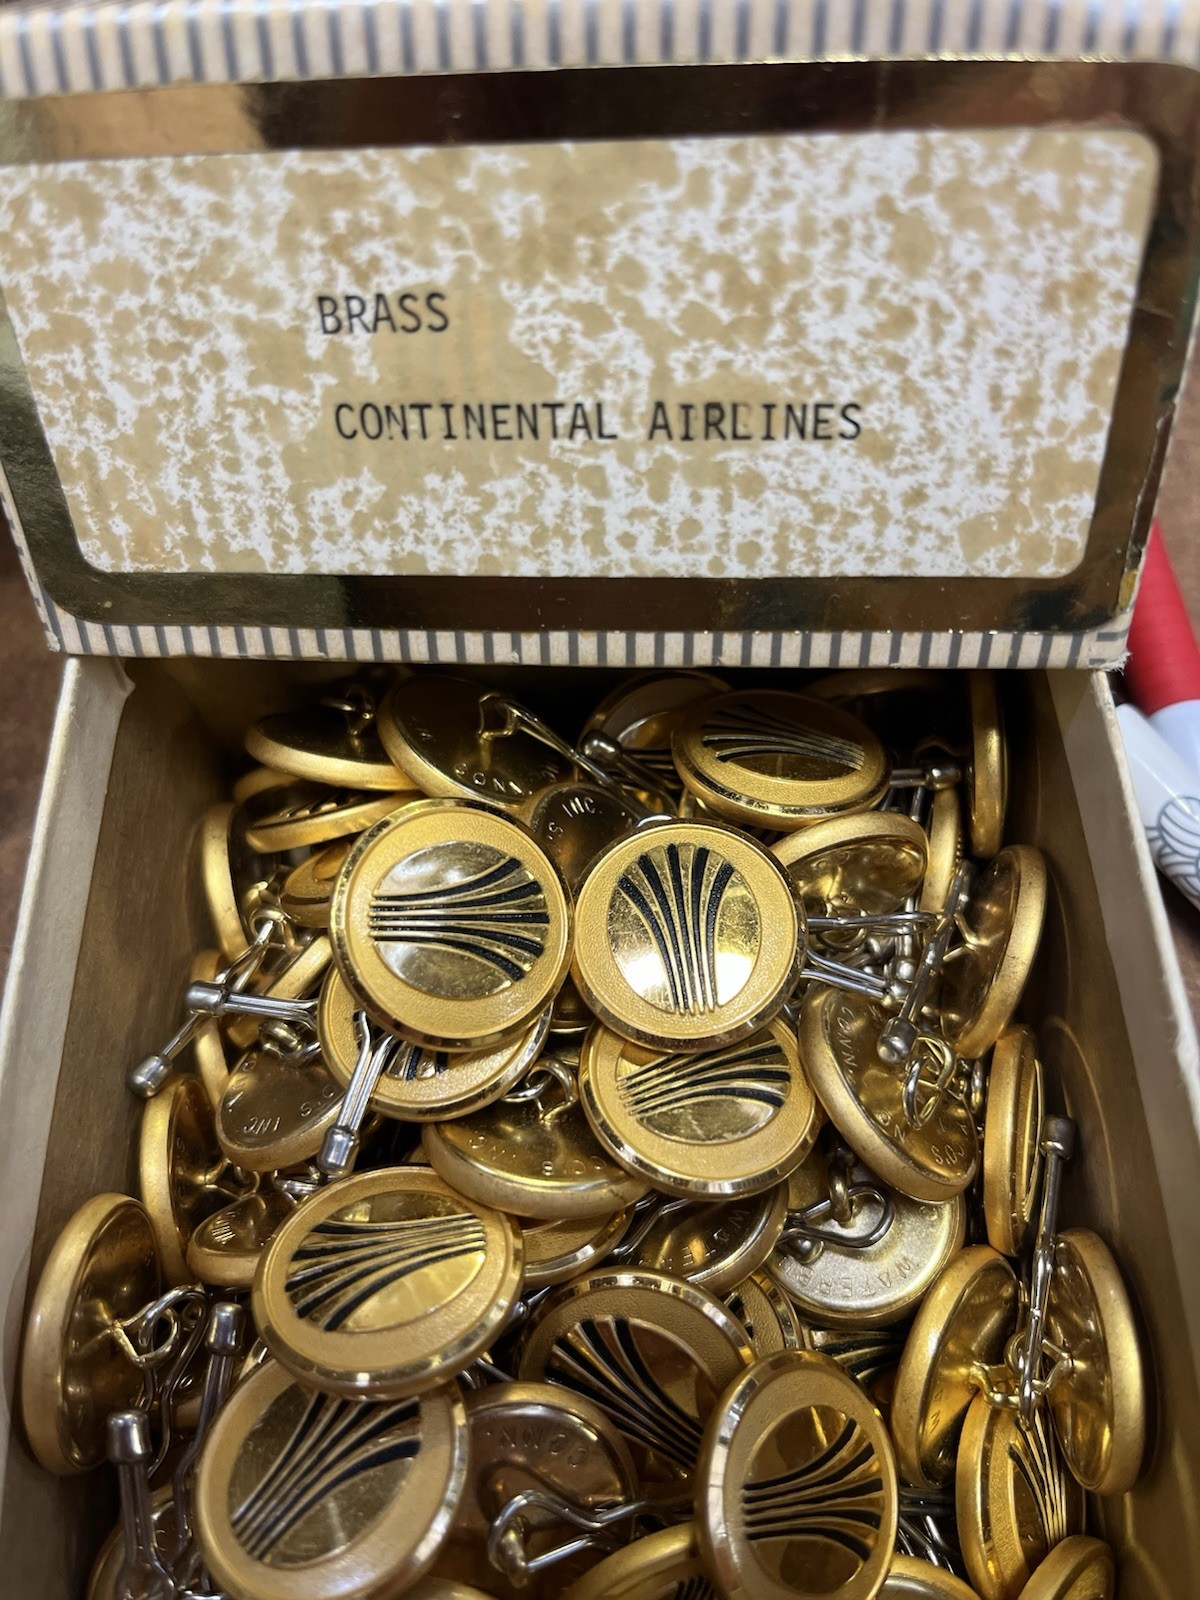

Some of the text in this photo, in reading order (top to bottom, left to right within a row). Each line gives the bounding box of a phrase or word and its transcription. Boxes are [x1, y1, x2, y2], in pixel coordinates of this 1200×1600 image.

[316, 292, 450, 336] BRASS
[334, 401, 863, 441] CONTINENTAL AIRLINES
